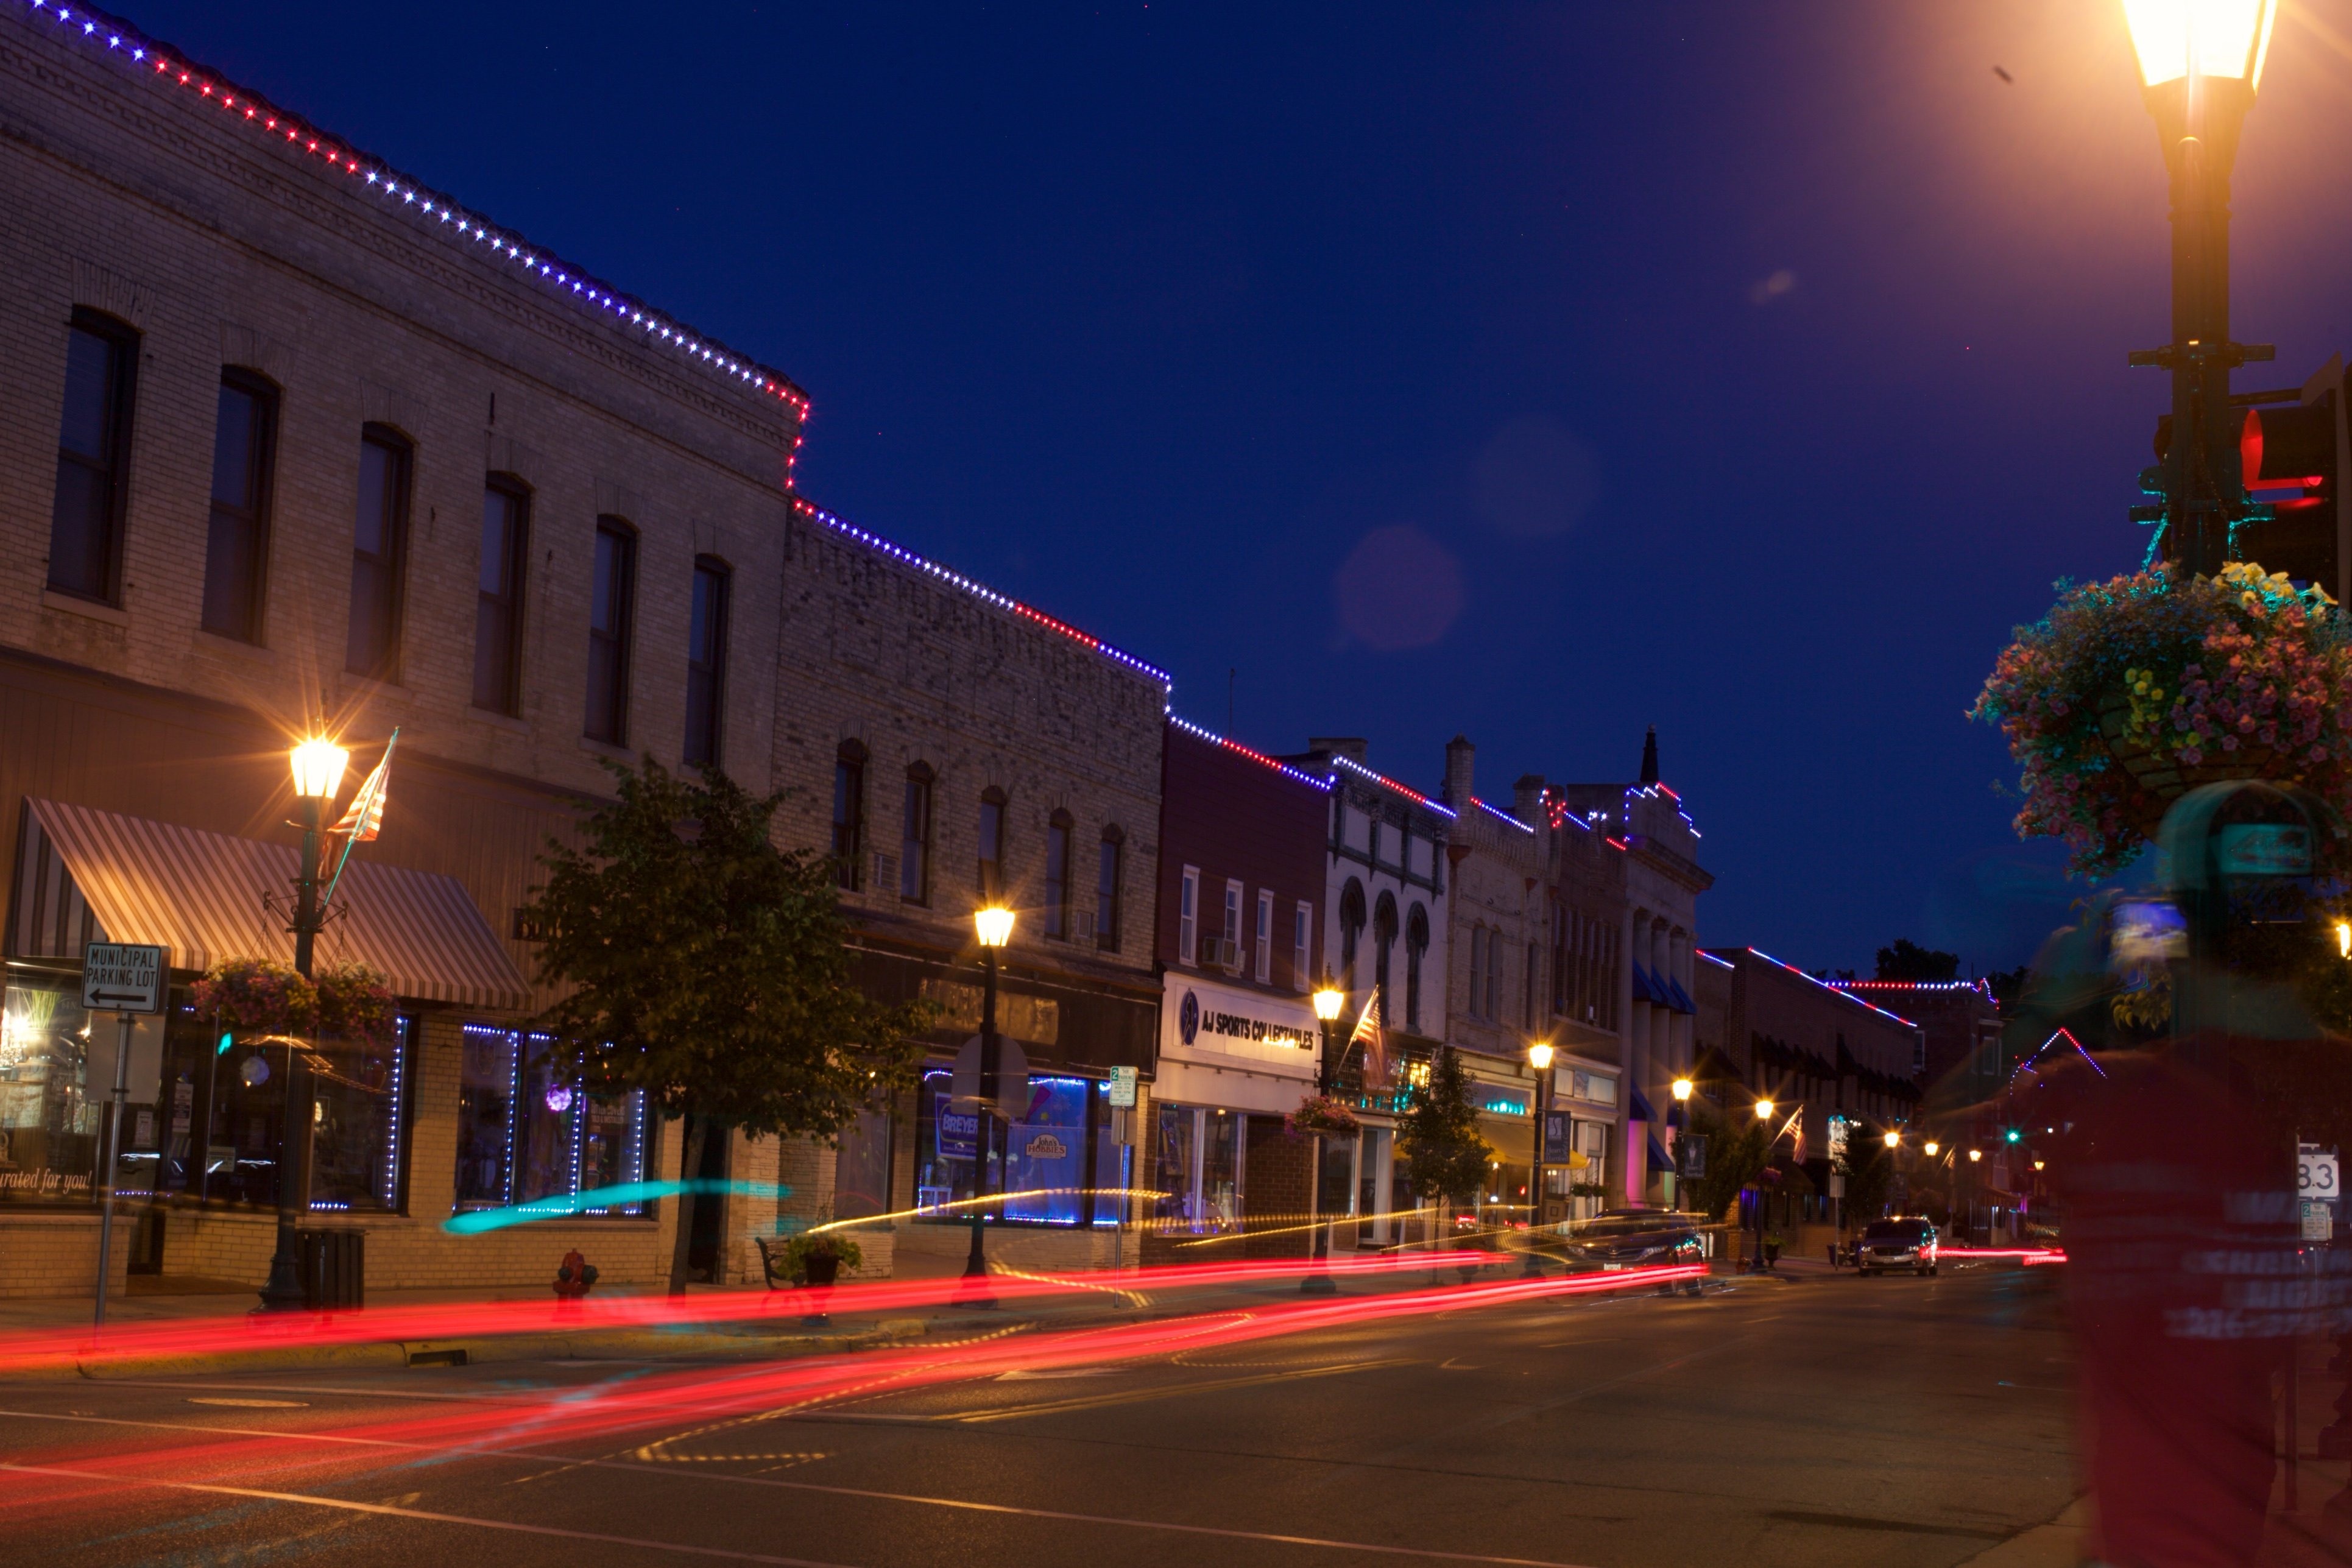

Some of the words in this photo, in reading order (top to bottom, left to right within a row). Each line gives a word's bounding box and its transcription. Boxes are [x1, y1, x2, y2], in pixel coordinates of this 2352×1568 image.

[91, 948, 154, 967] MUNICIPAL
[87, 967, 132, 986] PARKING
[136, 970, 156, 987] LOT
[1202, 1010, 1214, 1033] AJ
[1216, 1012, 1251, 1040] SPORTS
[1112, 1070, 1118, 1079] 2
[1037, 1137, 1057, 1148] John's
[0, 1168, 40, 1188] urated
[38, 1168, 61, 1194] for
[63, 1170, 92, 1194] you!
[2299, 1164, 2334, 1190] 83
[2304, 1206, 2309, 1215] 2
